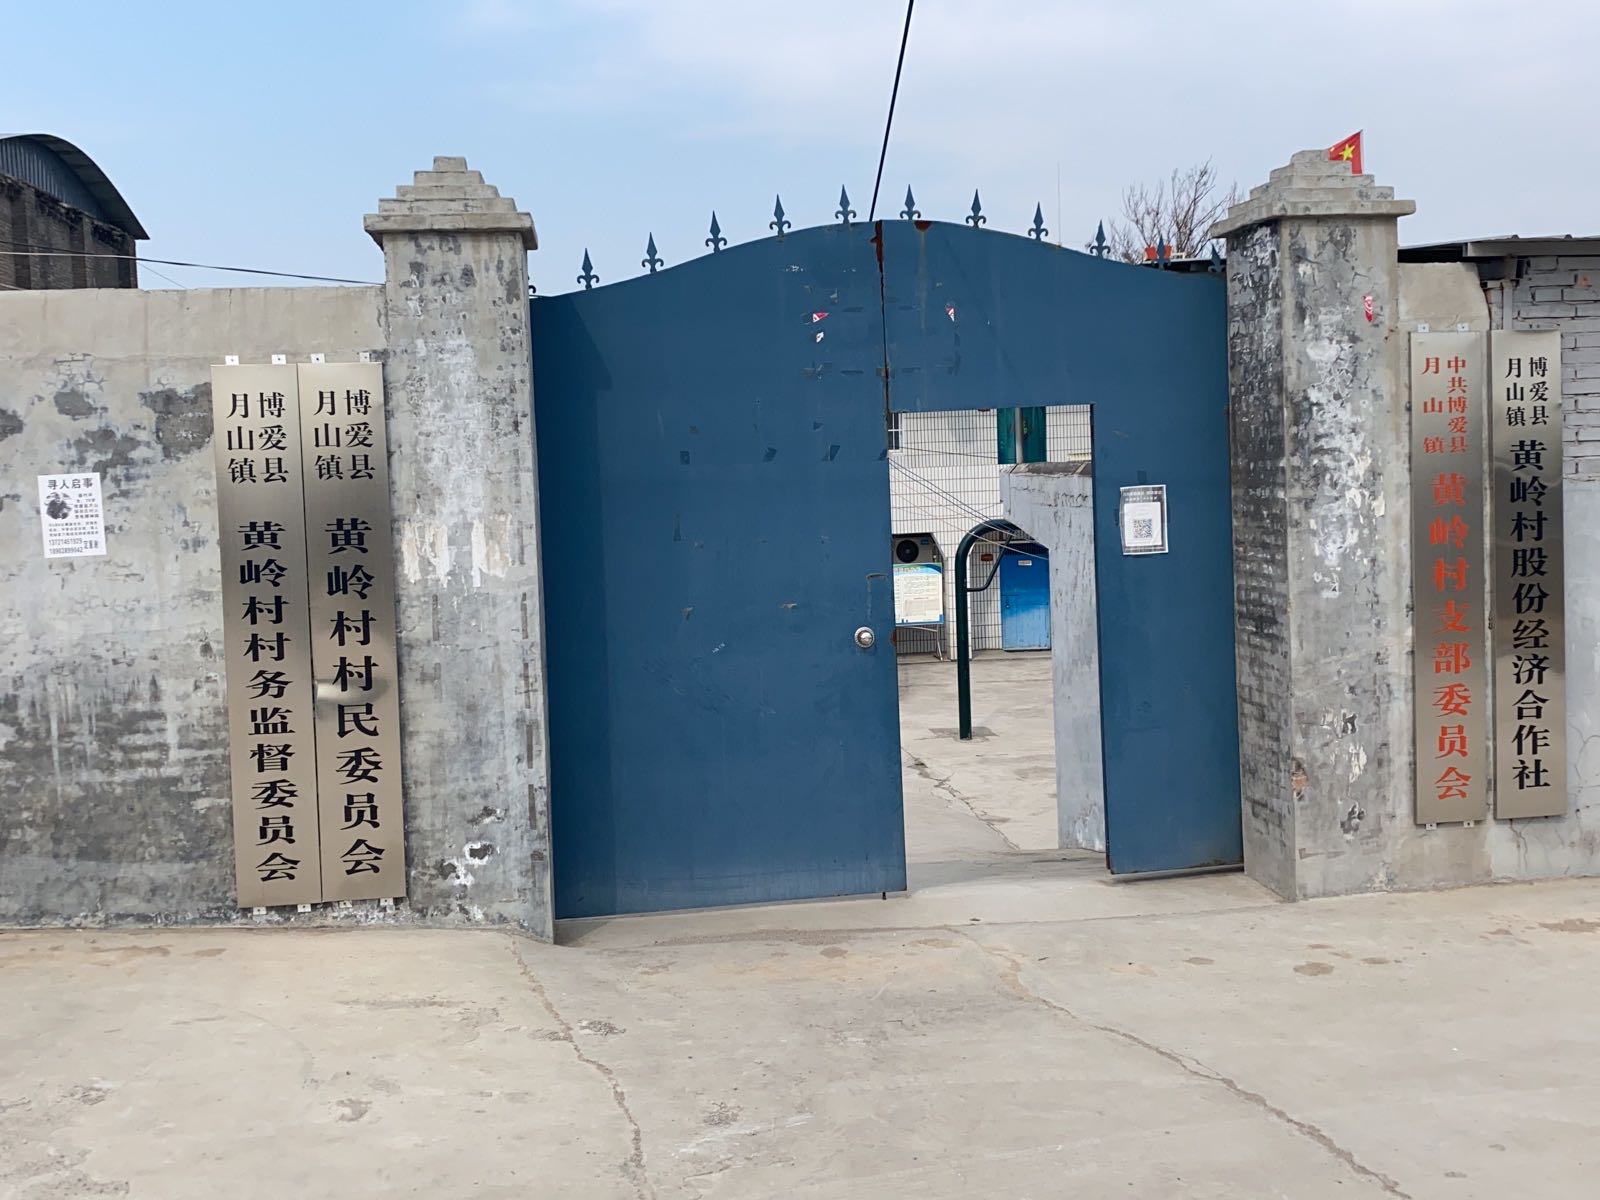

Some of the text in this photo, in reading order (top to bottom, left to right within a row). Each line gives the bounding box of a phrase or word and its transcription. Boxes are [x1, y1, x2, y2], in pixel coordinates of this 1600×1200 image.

[226, 392, 257, 484] 月山镇
[256, 391, 289, 484] 博爱县
[313, 389, 344, 482] 月山镇
[342, 388, 376, 481] 博爱县
[1421, 356, 1445, 455] 月山镇
[1446, 355, 1469, 454] 中共博爱县
[1504, 356, 1527, 428] 月山镇
[1528, 356, 1550, 427] 博爱县
[48, 478, 93, 490] 寻人启事
[1430, 472, 1473, 801] 黄岭村支部委员会
[1509, 439, 1551, 791] 黄岭村股份经济合作社
[237, 520, 301, 882] 黄岭村村务监督委员会
[325, 517, 386, 876] 黄岭村村民委员会
